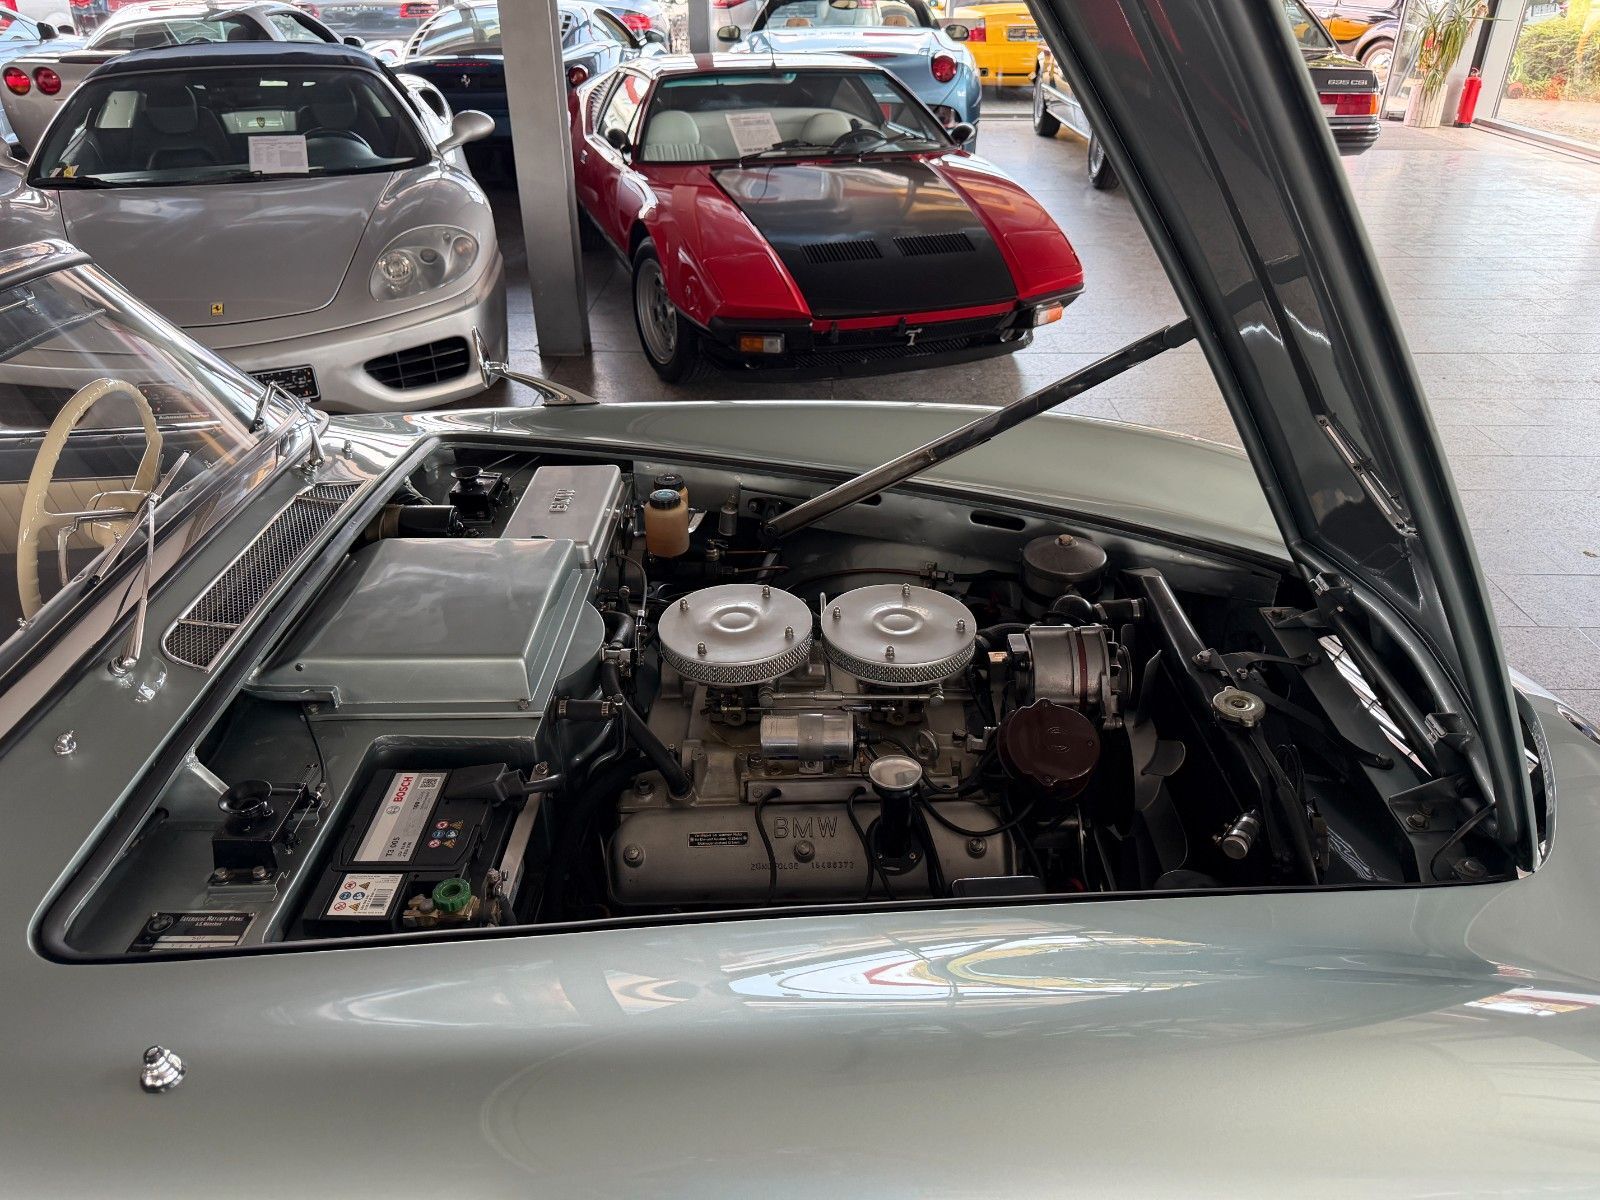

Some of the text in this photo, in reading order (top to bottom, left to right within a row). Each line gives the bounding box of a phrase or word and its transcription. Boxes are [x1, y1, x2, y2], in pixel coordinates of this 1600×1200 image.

[549, 488, 576, 513] BMW
[393, 776, 413, 803] BOSCH
[773, 816, 838, 839] BMW
[385, 836, 400, 858] T3 005
